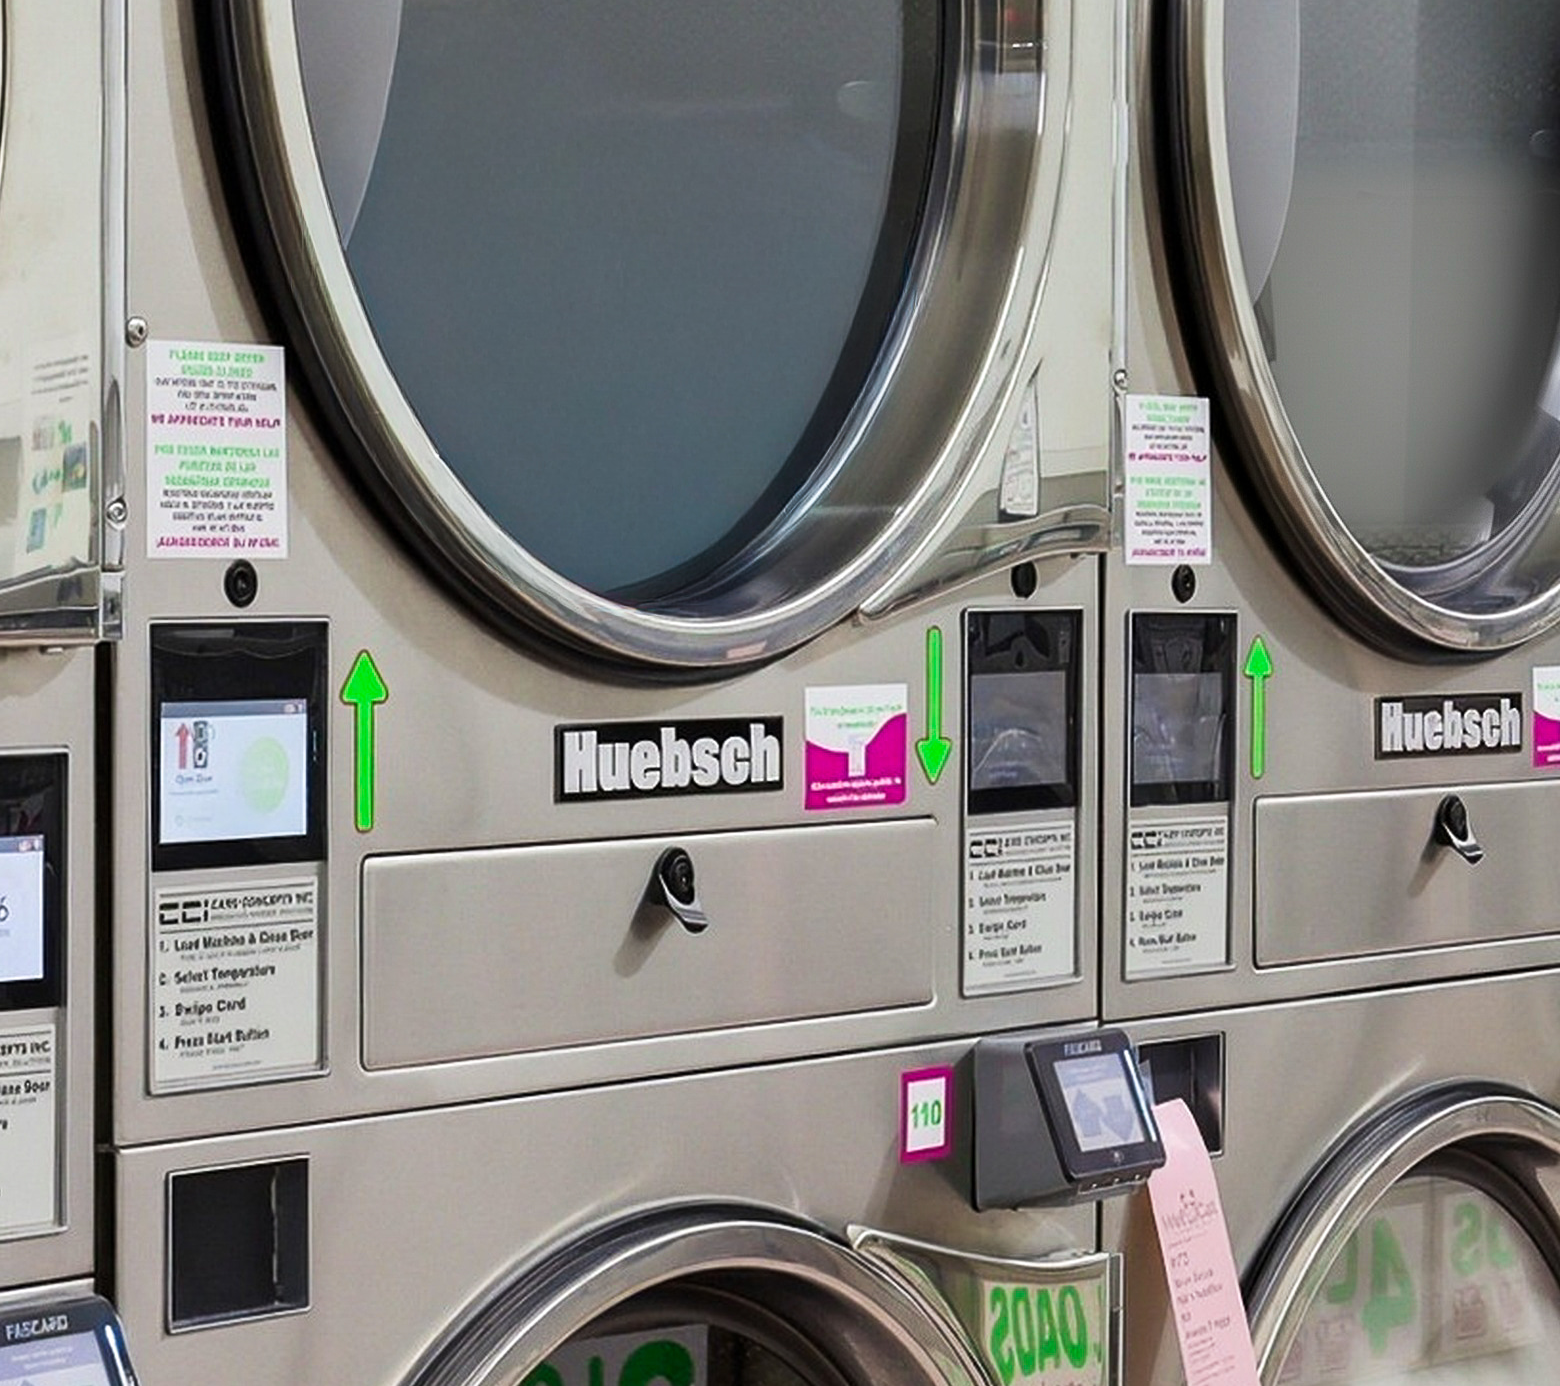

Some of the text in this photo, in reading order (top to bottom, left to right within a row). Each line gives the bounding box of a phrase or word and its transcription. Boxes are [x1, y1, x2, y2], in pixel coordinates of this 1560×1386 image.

[1382, 699, 1520, 751] Huebsch
[564, 724, 779, 794] Huebsch
[911, 1100, 941, 1128] 110
